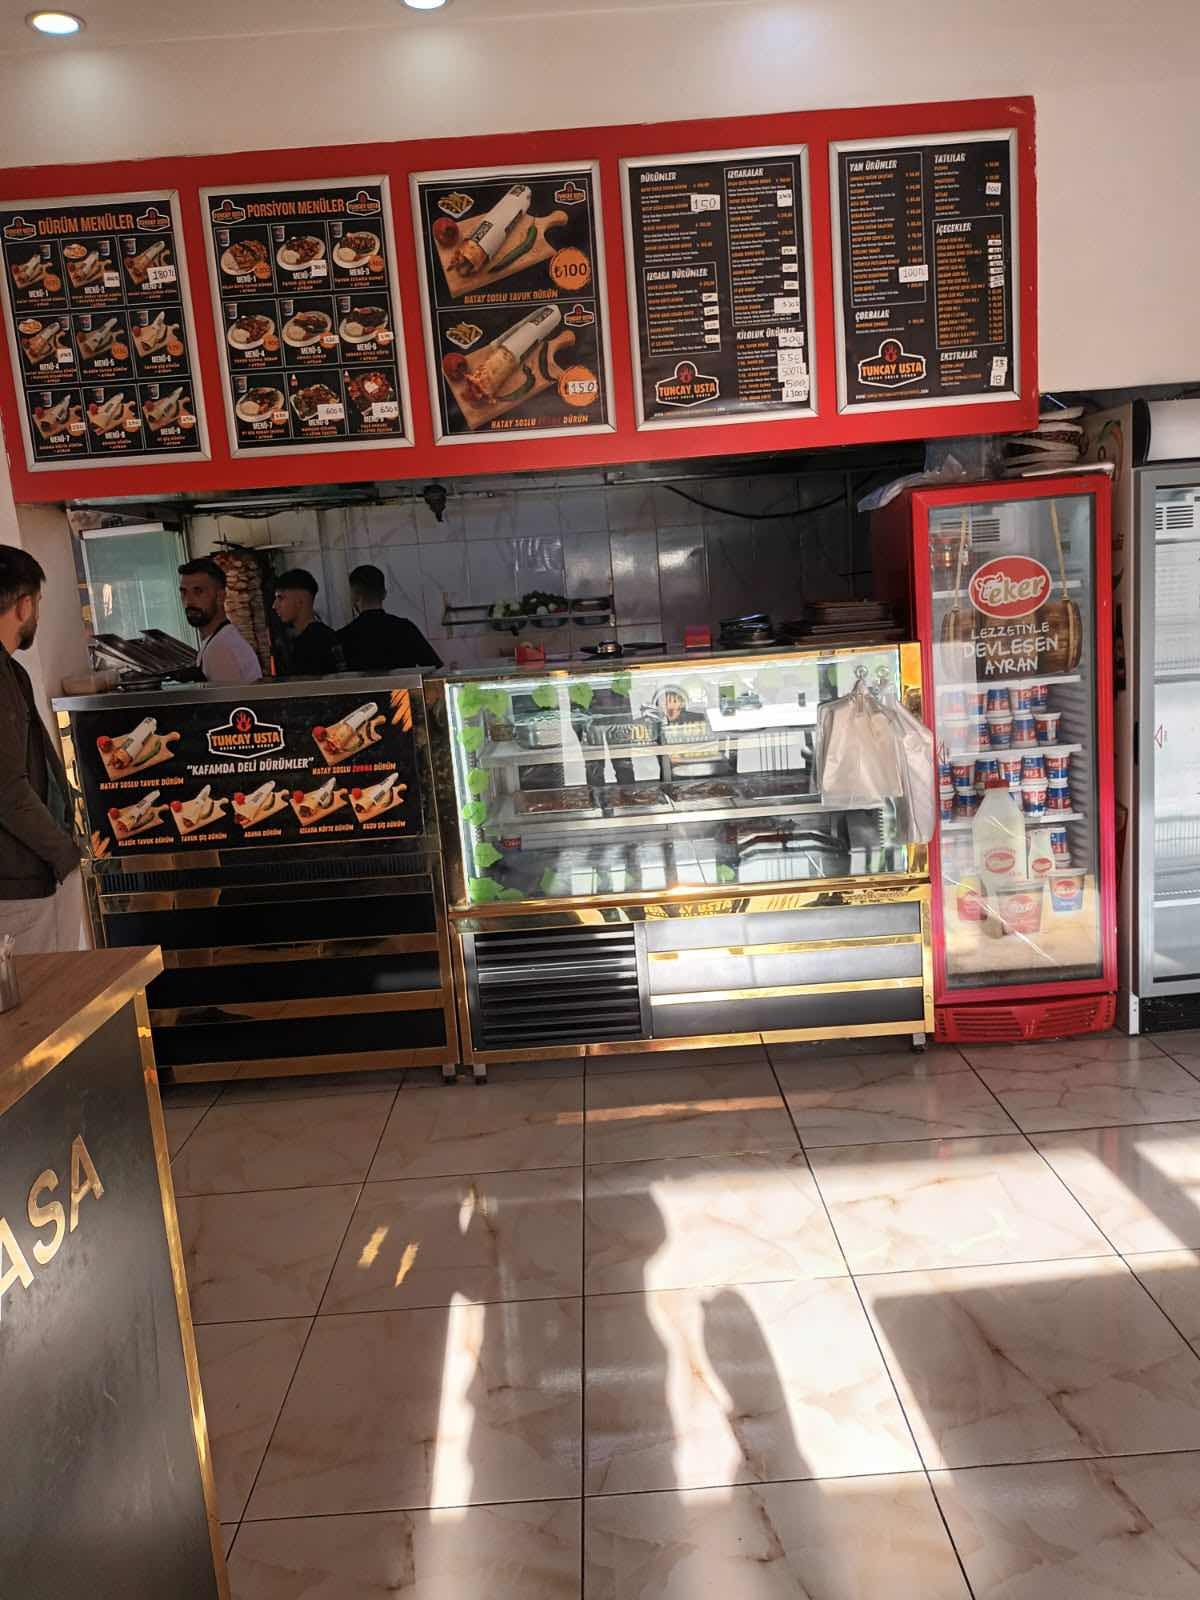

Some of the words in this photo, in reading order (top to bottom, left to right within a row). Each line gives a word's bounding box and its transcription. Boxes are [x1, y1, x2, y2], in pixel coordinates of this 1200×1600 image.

[247, 200, 296, 217] PORSİYON
[297, 197, 345, 215] MENÜLER
[38, 216, 79, 235] DÜRÜM
[80, 213, 134, 231] MENÜLER
[862, 364, 896, 376] TUNCAY
[898, 362, 922, 374] USTA
[659, 385, 692, 397] TUNCAY
[693, 382, 715, 393] USTA
[984, 574, 1045, 606] eker
[985, 656, 1038, 675] AYRAN
[211, 734, 251, 747] TUNCAY
[253, 731, 280, 744] USTA
[237, 760, 257, 773] DELİ
[140, 779, 160, 788] TAVUK
[160, 777, 184, 787] DÜRÜM
